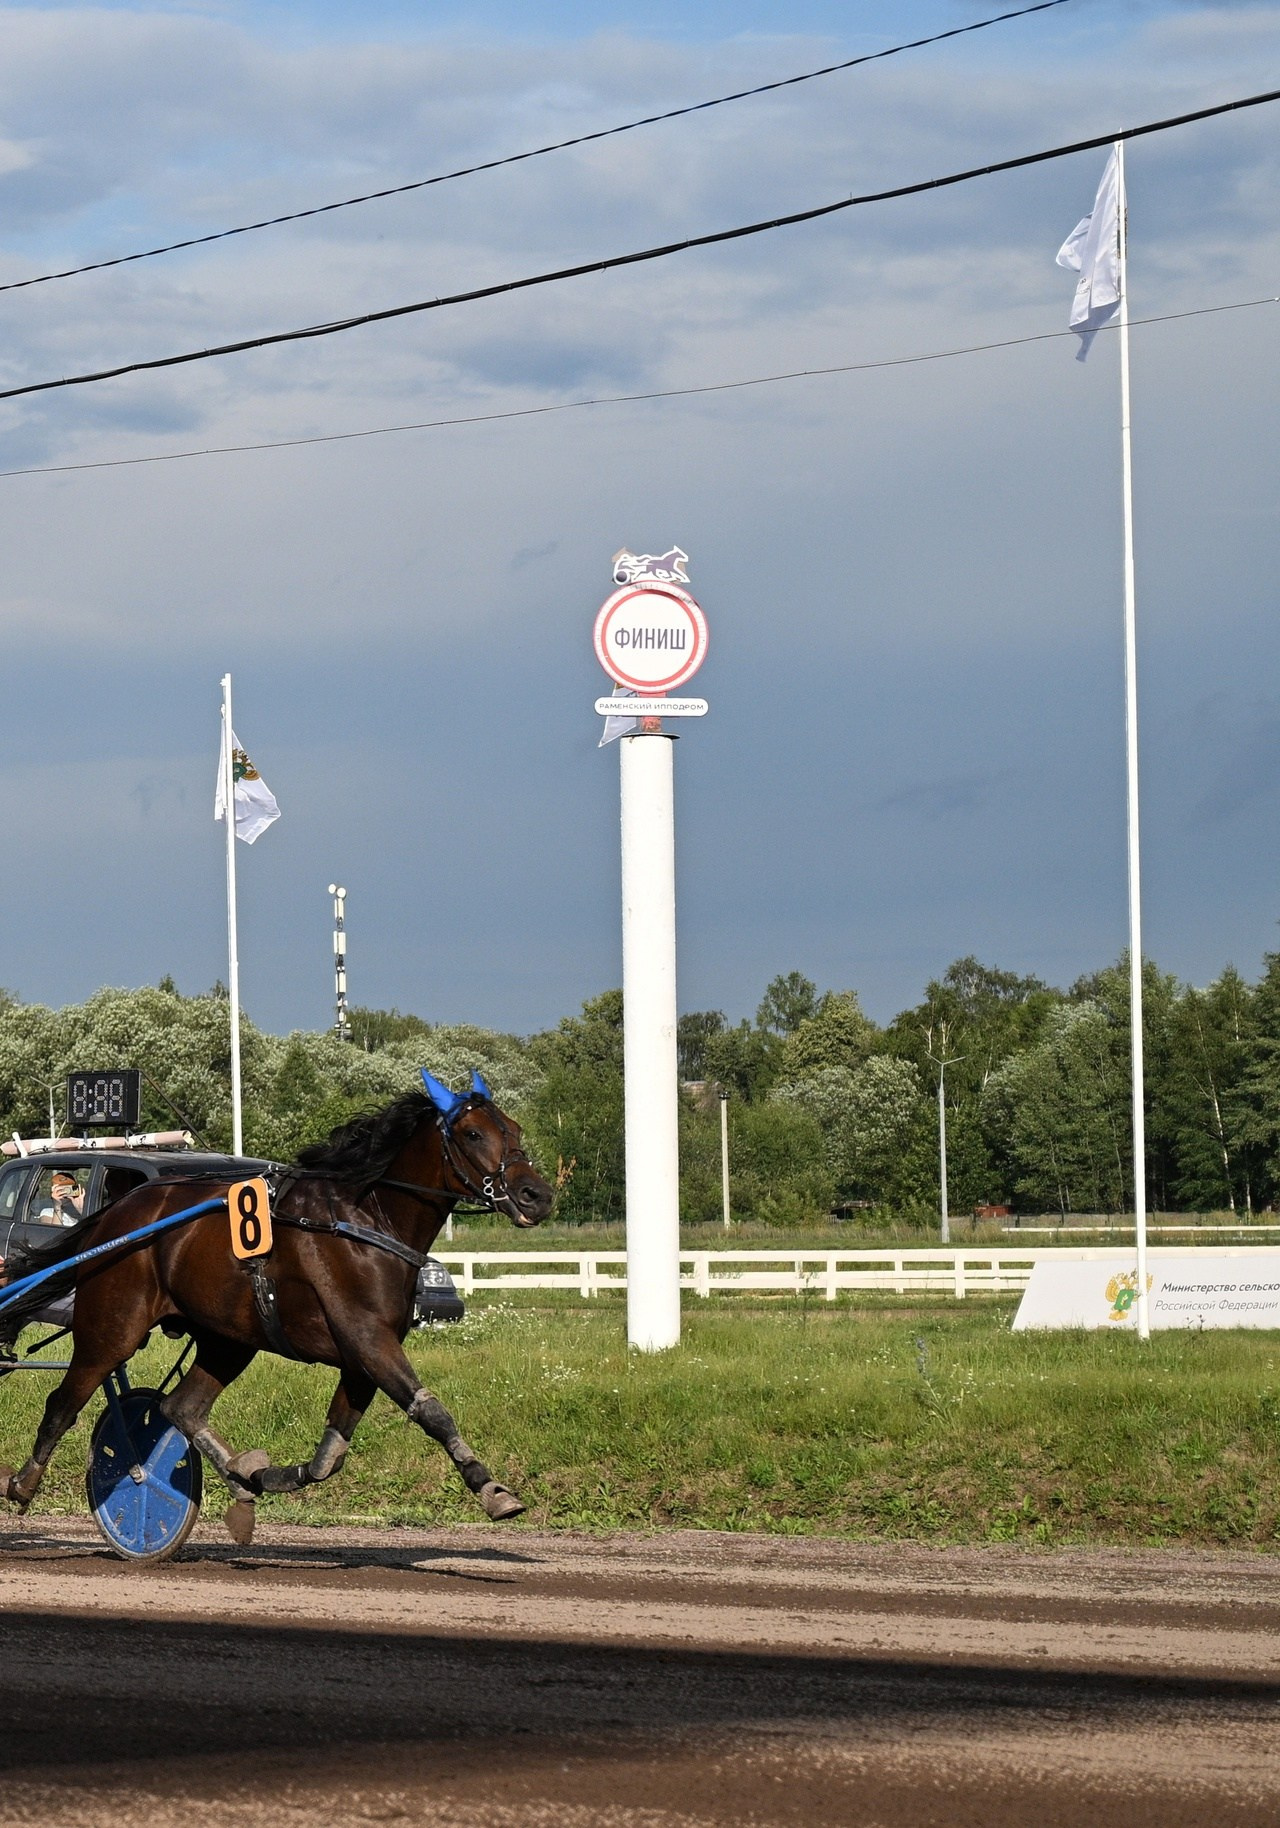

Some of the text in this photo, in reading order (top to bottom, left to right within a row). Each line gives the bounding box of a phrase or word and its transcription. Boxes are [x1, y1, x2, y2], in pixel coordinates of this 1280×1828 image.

[614, 627, 686, 650] ФИНИШ
[237, 1185, 262, 1251] 8
[1160, 1282, 1237, 1295] Министерство
[1154, 1299, 1279, 1312] Российской Федерации
